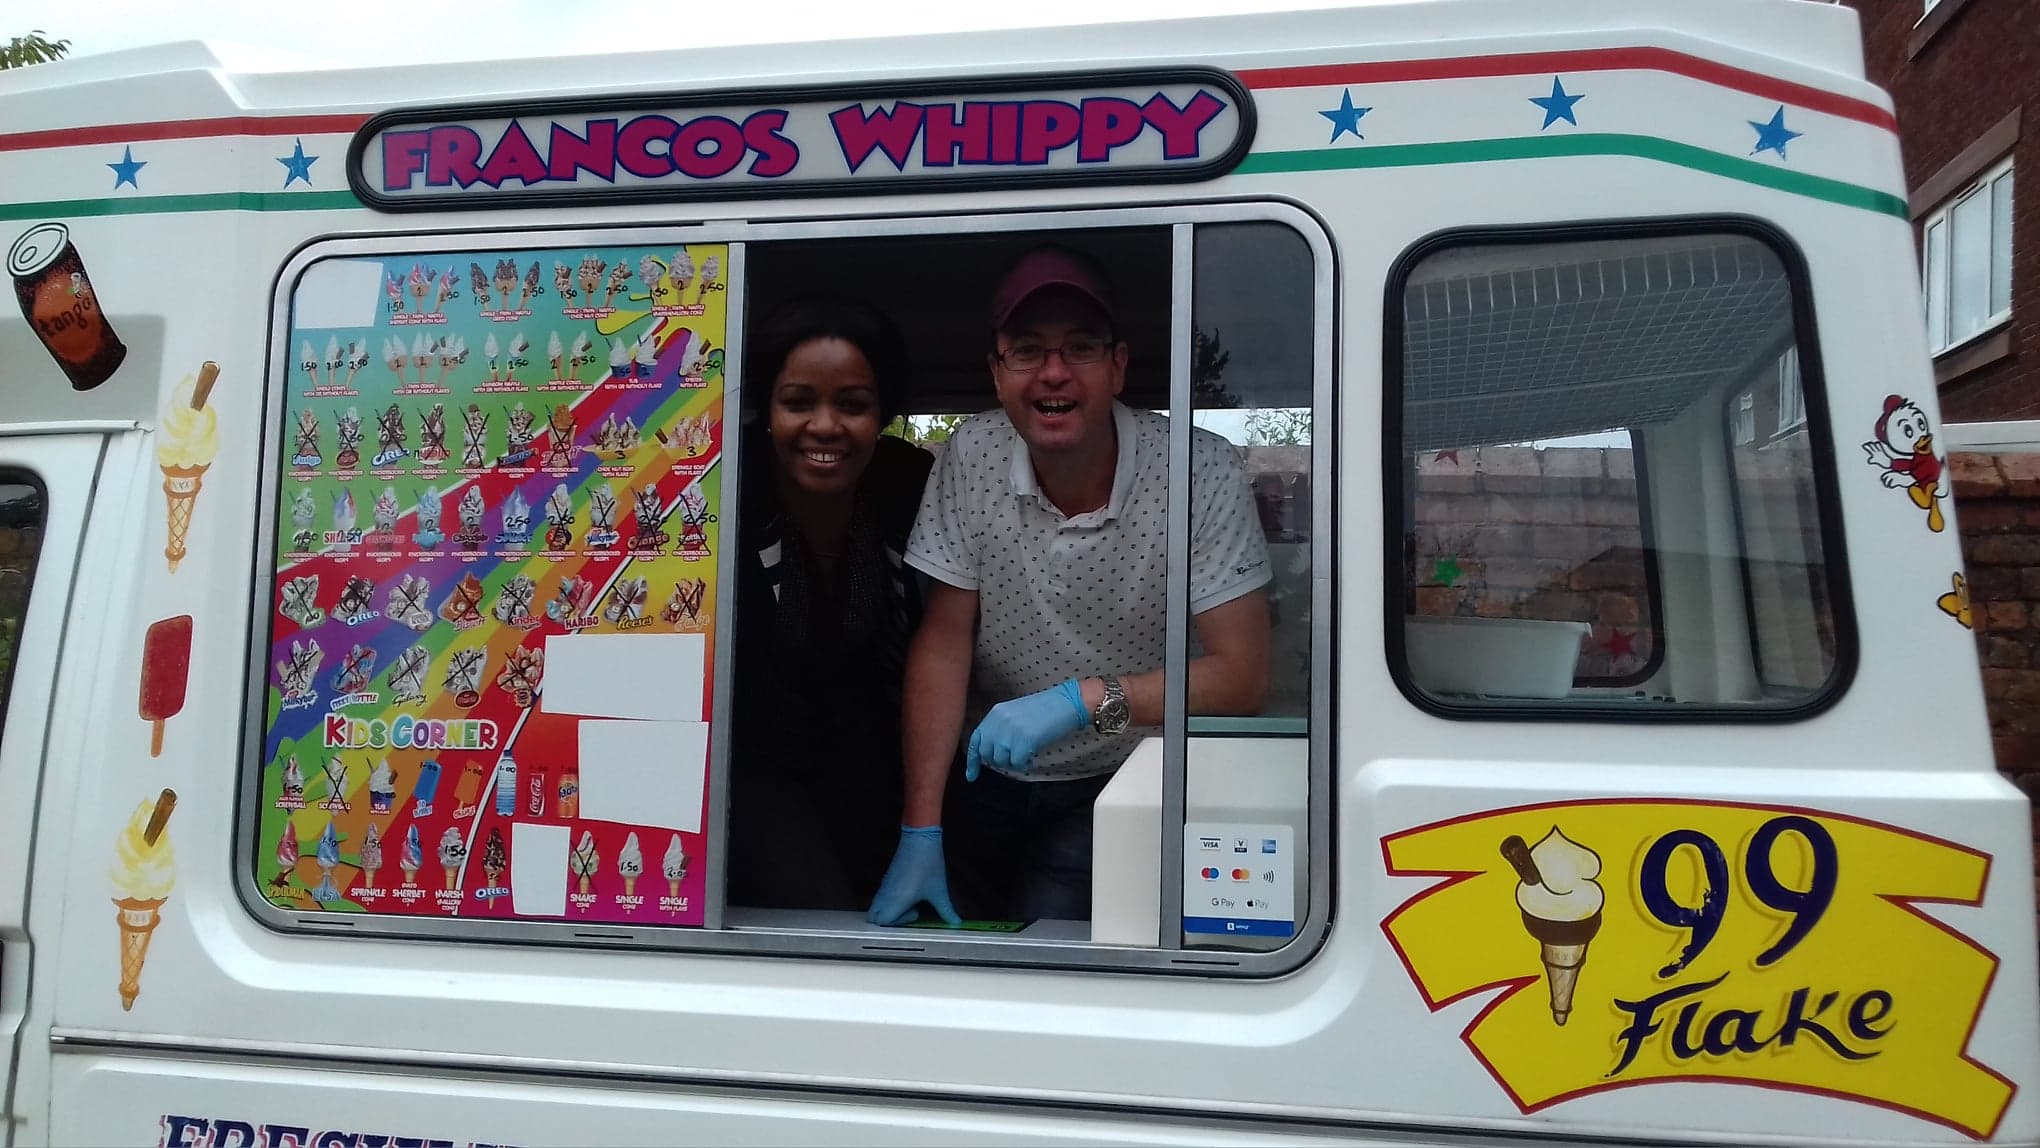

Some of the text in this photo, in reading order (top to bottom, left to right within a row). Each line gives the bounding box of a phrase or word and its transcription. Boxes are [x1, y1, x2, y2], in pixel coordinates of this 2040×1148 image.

[382, 88, 1228, 191] FRANCOS WHIPPY
[587, 282, 594, 293] 2
[677, 280, 684, 290] 2
[387, 301, 404, 312] 1.50
[37, 297, 92, 338] tango
[489, 360, 497, 370] 2
[551, 359, 558, 369] 2
[615, 450, 626, 460] 3
[687, 447, 697, 457] 3
[346, 610, 380, 626] OREO
[507, 615, 540, 626] Kinder
[565, 616, 599, 629] HARIBO
[392, 692, 428, 707] Galaxy
[325, 714, 498, 749] KIDS CORNER
[444, 845, 467, 856] 1.50
[1202, 841, 1219, 849] VISA
[620, 861, 639, 872] 1.50
[351, 888, 386, 897] SPRINKLE
[392, 889, 426, 898] SHERBET
[435, 890, 464, 898] MARSH
[475, 887, 509, 898] OREO
[569, 893, 598, 903] SNAKE
[1638, 815, 1839, 979] 99
[615, 895, 644, 905] SINGLE
[659, 896, 689, 906] SINGLE
[1211, 897, 1235, 909] G Pay
[1255, 900, 1269, 910] Pay
[1604, 971, 1897, 1078] Flake
